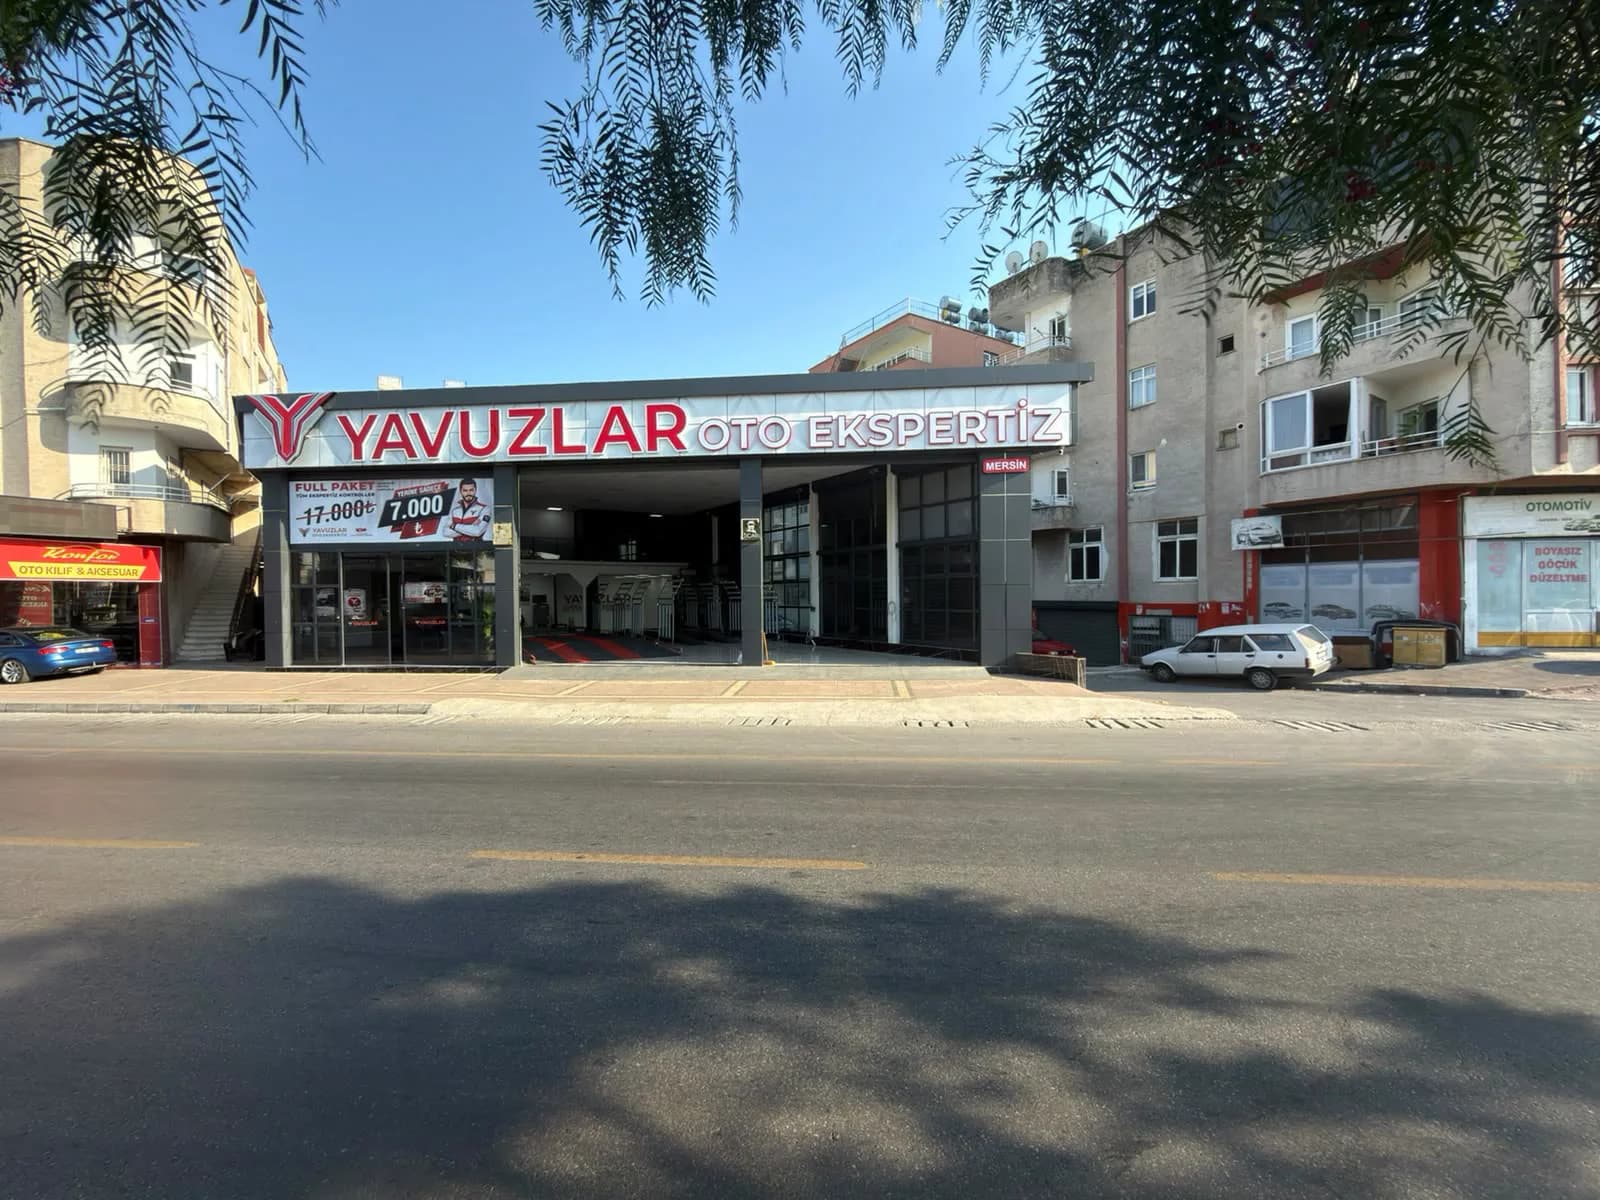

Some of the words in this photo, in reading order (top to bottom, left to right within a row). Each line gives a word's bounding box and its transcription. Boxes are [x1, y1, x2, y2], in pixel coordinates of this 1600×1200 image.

[337, 403, 688, 461] YAVUZLAR
[697, 415, 792, 451] OTO
[808, 398, 1063, 449] EKSPERTİZ
[985, 458, 1027, 472] MERSİN
[295, 483, 328, 492] FULL
[331, 481, 375, 491] PAKET
[390, 495, 443, 521] 7.000
[1526, 499, 1592, 512] OTOMOTİV
[43, 545, 120, 562] Konfor
[1535, 547, 1582, 556] BOYASIZ
[1538, 559, 1577, 570] GÖÇÜK
[19, 565, 43, 575] OTO
[76, 567, 86, 576] &
[86, 567, 138, 577] AKSESUAR
[1530, 573, 1588, 583] DÜZELTME
